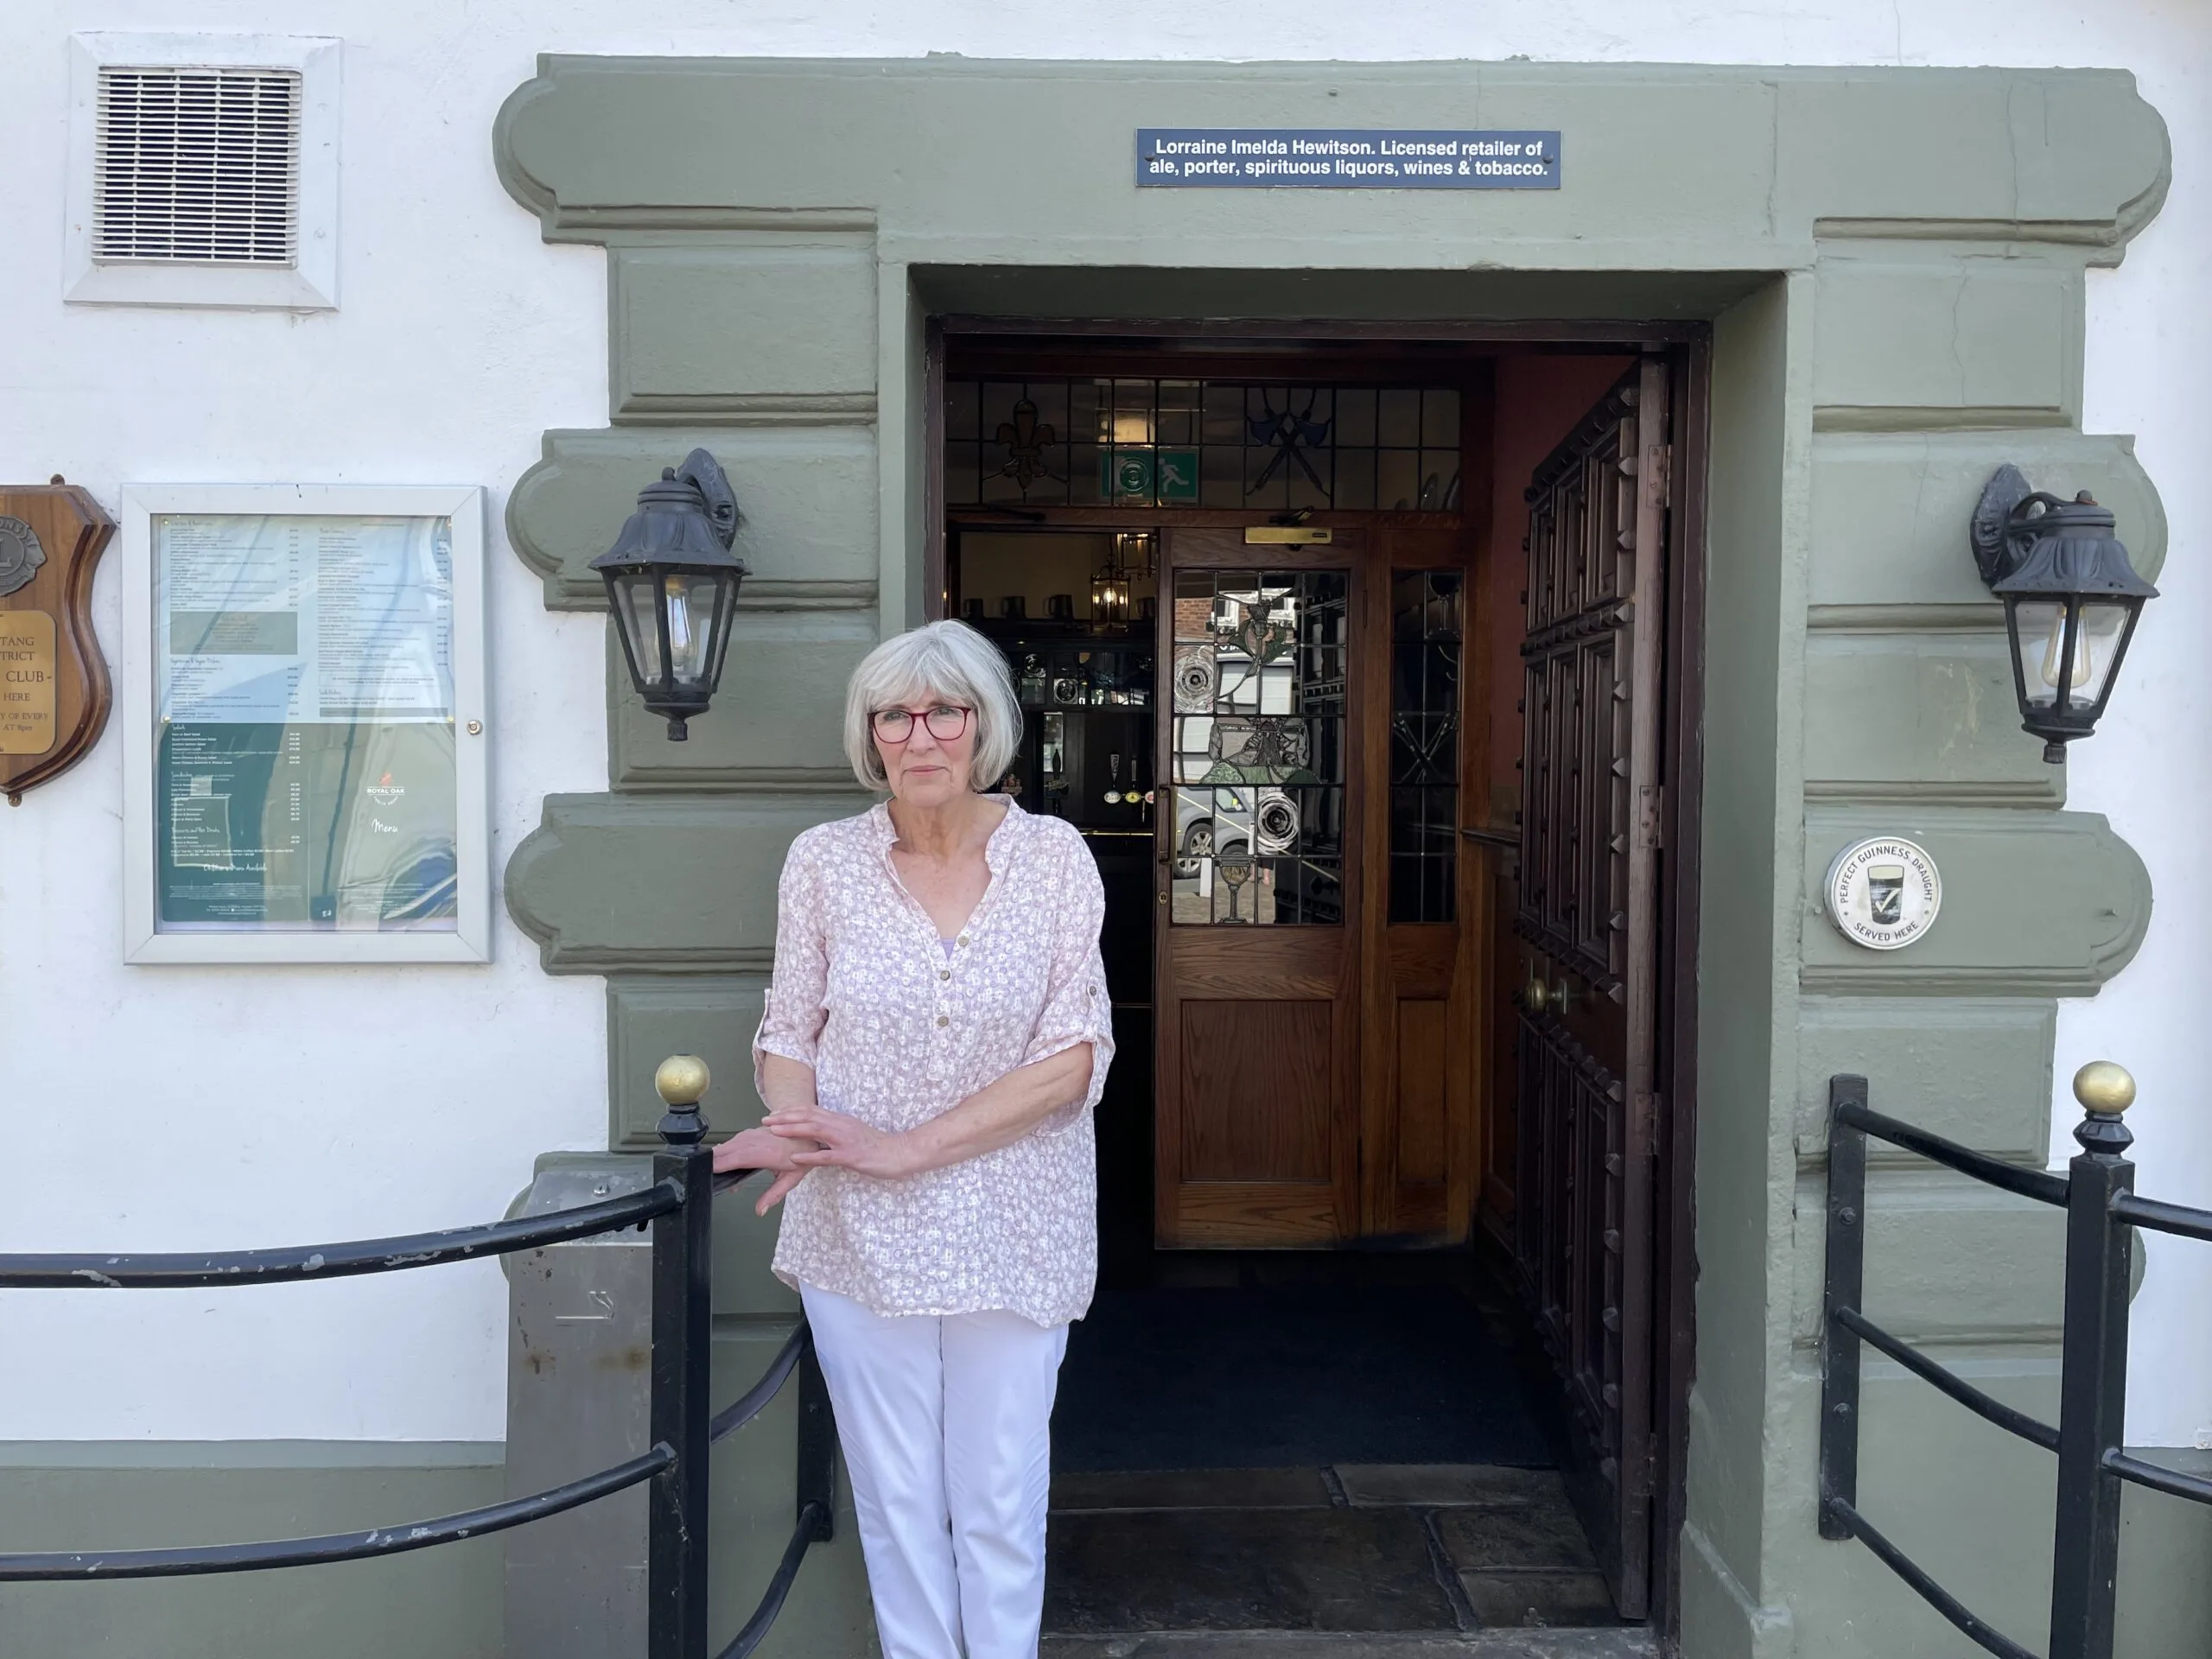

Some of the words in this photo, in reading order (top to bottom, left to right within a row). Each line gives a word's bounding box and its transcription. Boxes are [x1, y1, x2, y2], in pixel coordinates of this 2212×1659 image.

[1155, 139, 1227, 155] Lorraine
[1231, 139, 1287, 155] Imelda
[1292, 140, 1376, 156] Hewitson.
[1381, 140, 1457, 156] Licensed
[1461, 141, 1521, 156] retailer
[1525, 141, 1543, 156] of
[1149, 159, 1179, 175] ale,
[1184, 161, 1240, 177] porter,
[1244, 159, 1331, 177] spirituous
[1335, 159, 1399, 177] liquors,
[1403, 160, 1453, 175] wines
[1458, 160, 1470, 175] &
[1475, 161, 1548, 175] tobacco.
[5, 671, 44, 683] CLUB
[3, 692, 30, 702] HERE
[372, 818, 398, 833] Menu
[1840, 861, 1859, 904] PERFECT
[1857, 845, 1911, 863] GUINNESS
[1911, 858, 1933, 902] DRAUGHT
[1853, 922, 1891, 942] SERVED
[1894, 920, 1919, 940] HERE
